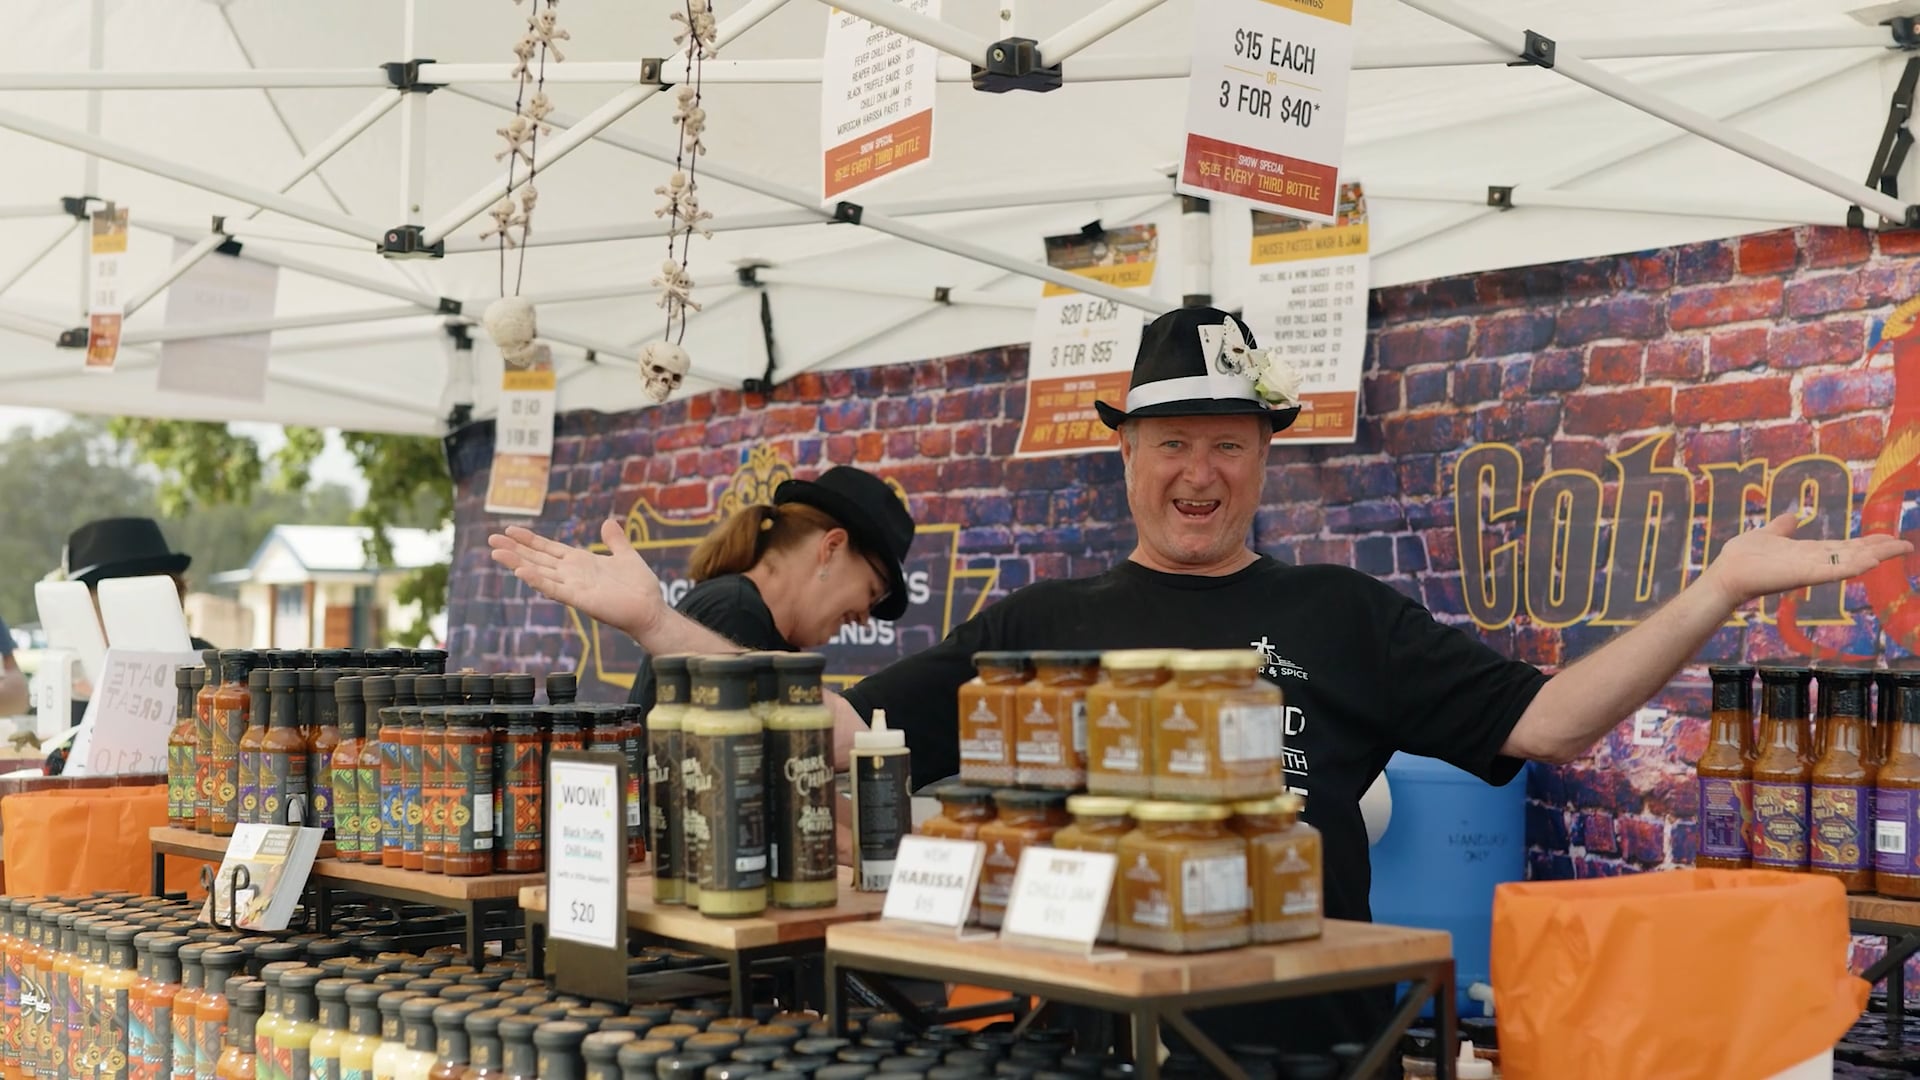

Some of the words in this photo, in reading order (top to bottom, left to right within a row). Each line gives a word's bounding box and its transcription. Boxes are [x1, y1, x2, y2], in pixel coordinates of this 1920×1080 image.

[1235, 28, 1264, 61] $15
[1270, 38, 1316, 75] EACH
[1266, 71, 1278, 86] OR
[1219, 80, 1230, 108] 3
[1237, 84, 1272, 119] FOR
[837, 118, 861, 136] MOROCCAN
[863, 108, 883, 125] HARISSA
[894, 136, 920, 158] BOTTLE
[1238, 155, 1257, 168] SHOW
[1259, 161, 1285, 175] SPECIAL
[1224, 166, 1255, 187] EVERY
[1258, 173, 1284, 193] THIRD
[1286, 180, 1321, 201] BOTTLE
[1060, 303, 1082, 325] $20
[1086, 300, 1119, 322] EACH
[1050, 346, 1058, 367] 3
[1062, 344, 1086, 366] FOR
[1455, 432, 1855, 630] Cobra
[828, 617, 896, 645] NDS
[1268, 666, 1278, 677] &
[1281, 667, 1309, 680] SPICE
[562, 785, 606, 808] WOW!
[897, 870, 963, 888] HARISSA
[571, 899, 595, 923] $20
